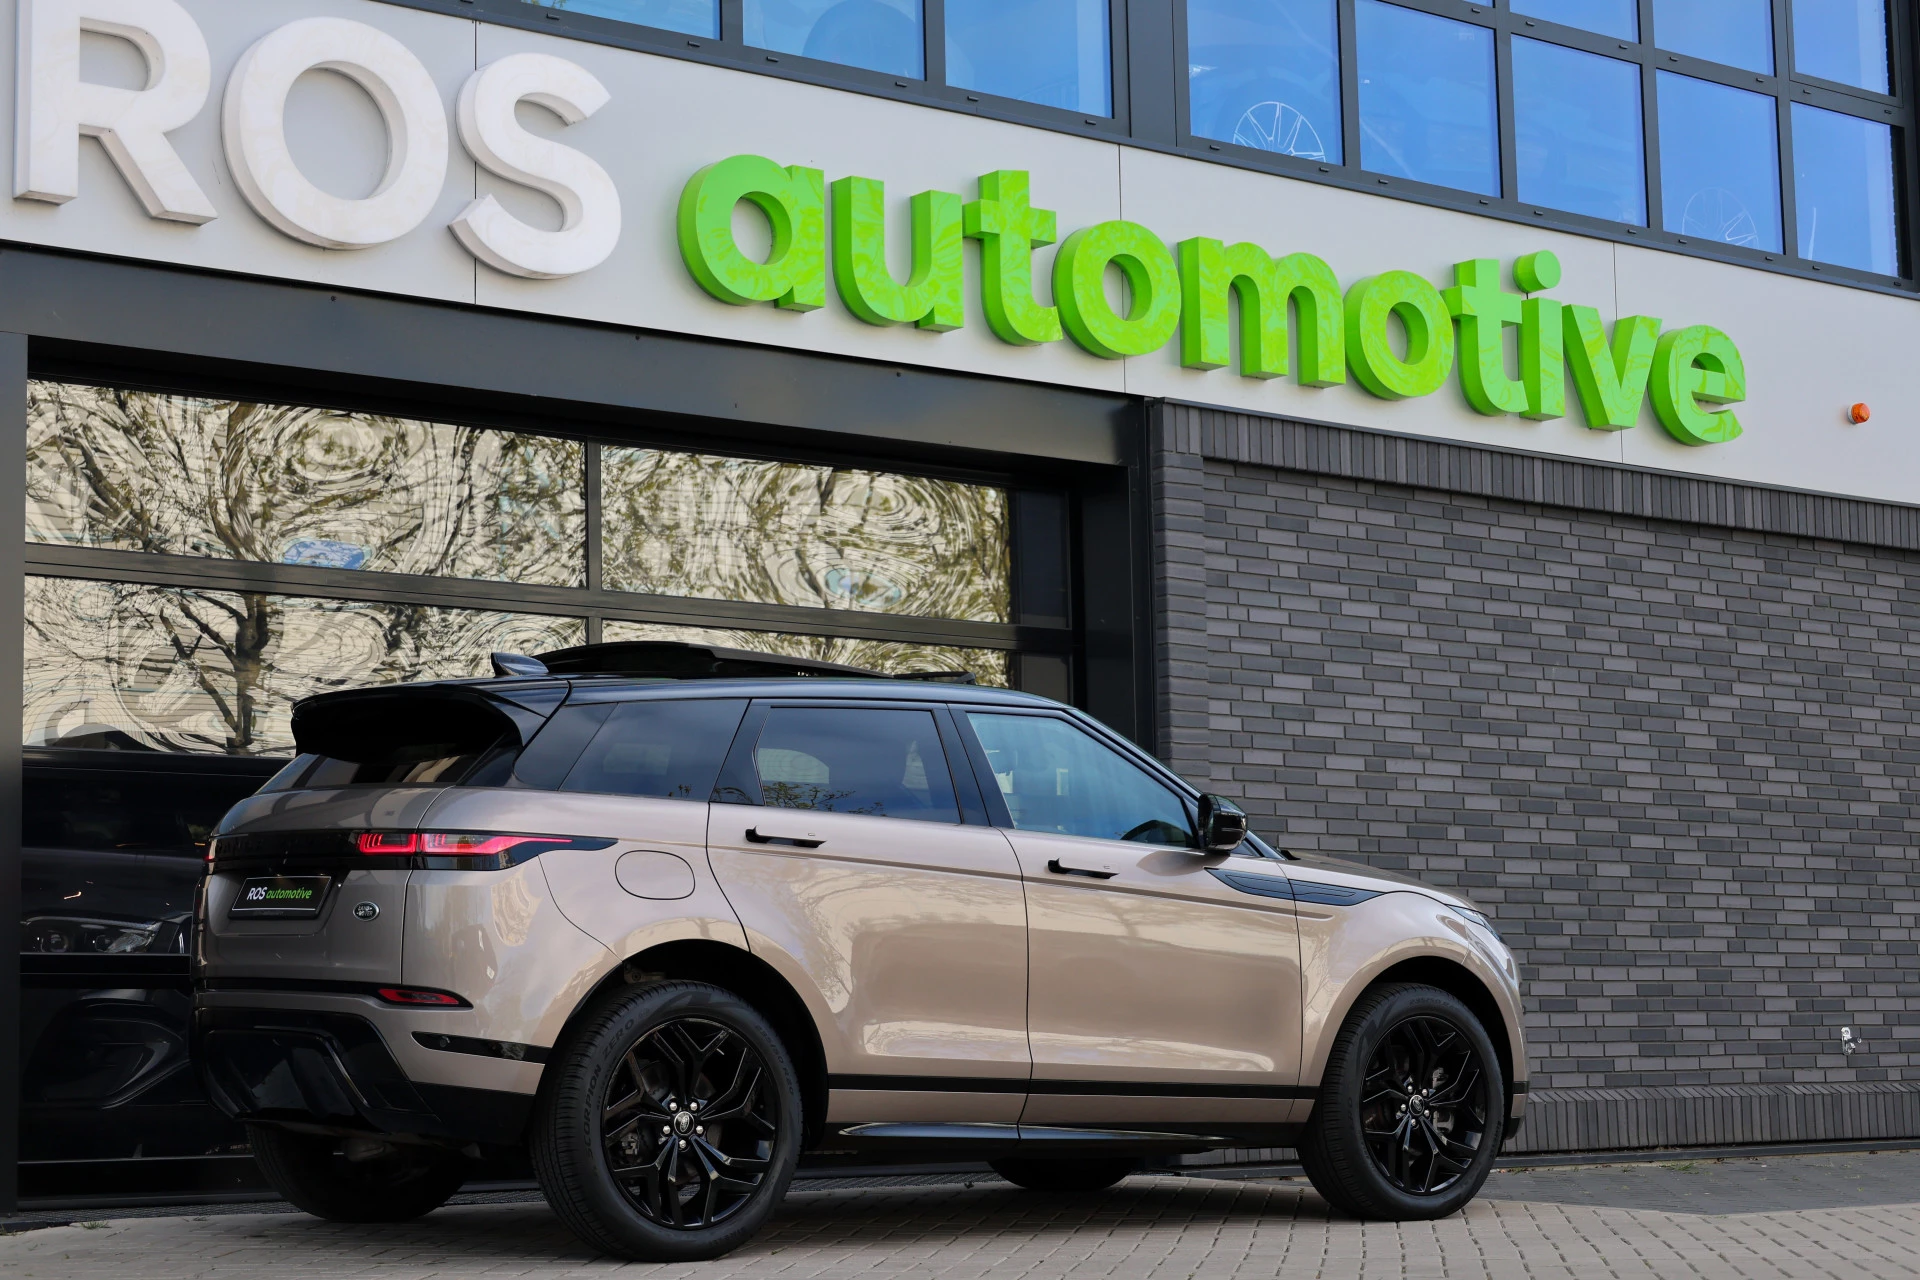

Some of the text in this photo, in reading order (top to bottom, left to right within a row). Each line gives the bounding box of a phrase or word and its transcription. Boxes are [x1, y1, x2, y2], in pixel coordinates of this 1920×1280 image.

[13, 0, 1746, 446] ROS automotive
[247, 887, 313, 900] ROS automotive
[583, 1063, 602, 1160] SCORPION
[603, 1018, 635, 1061] ZERO
